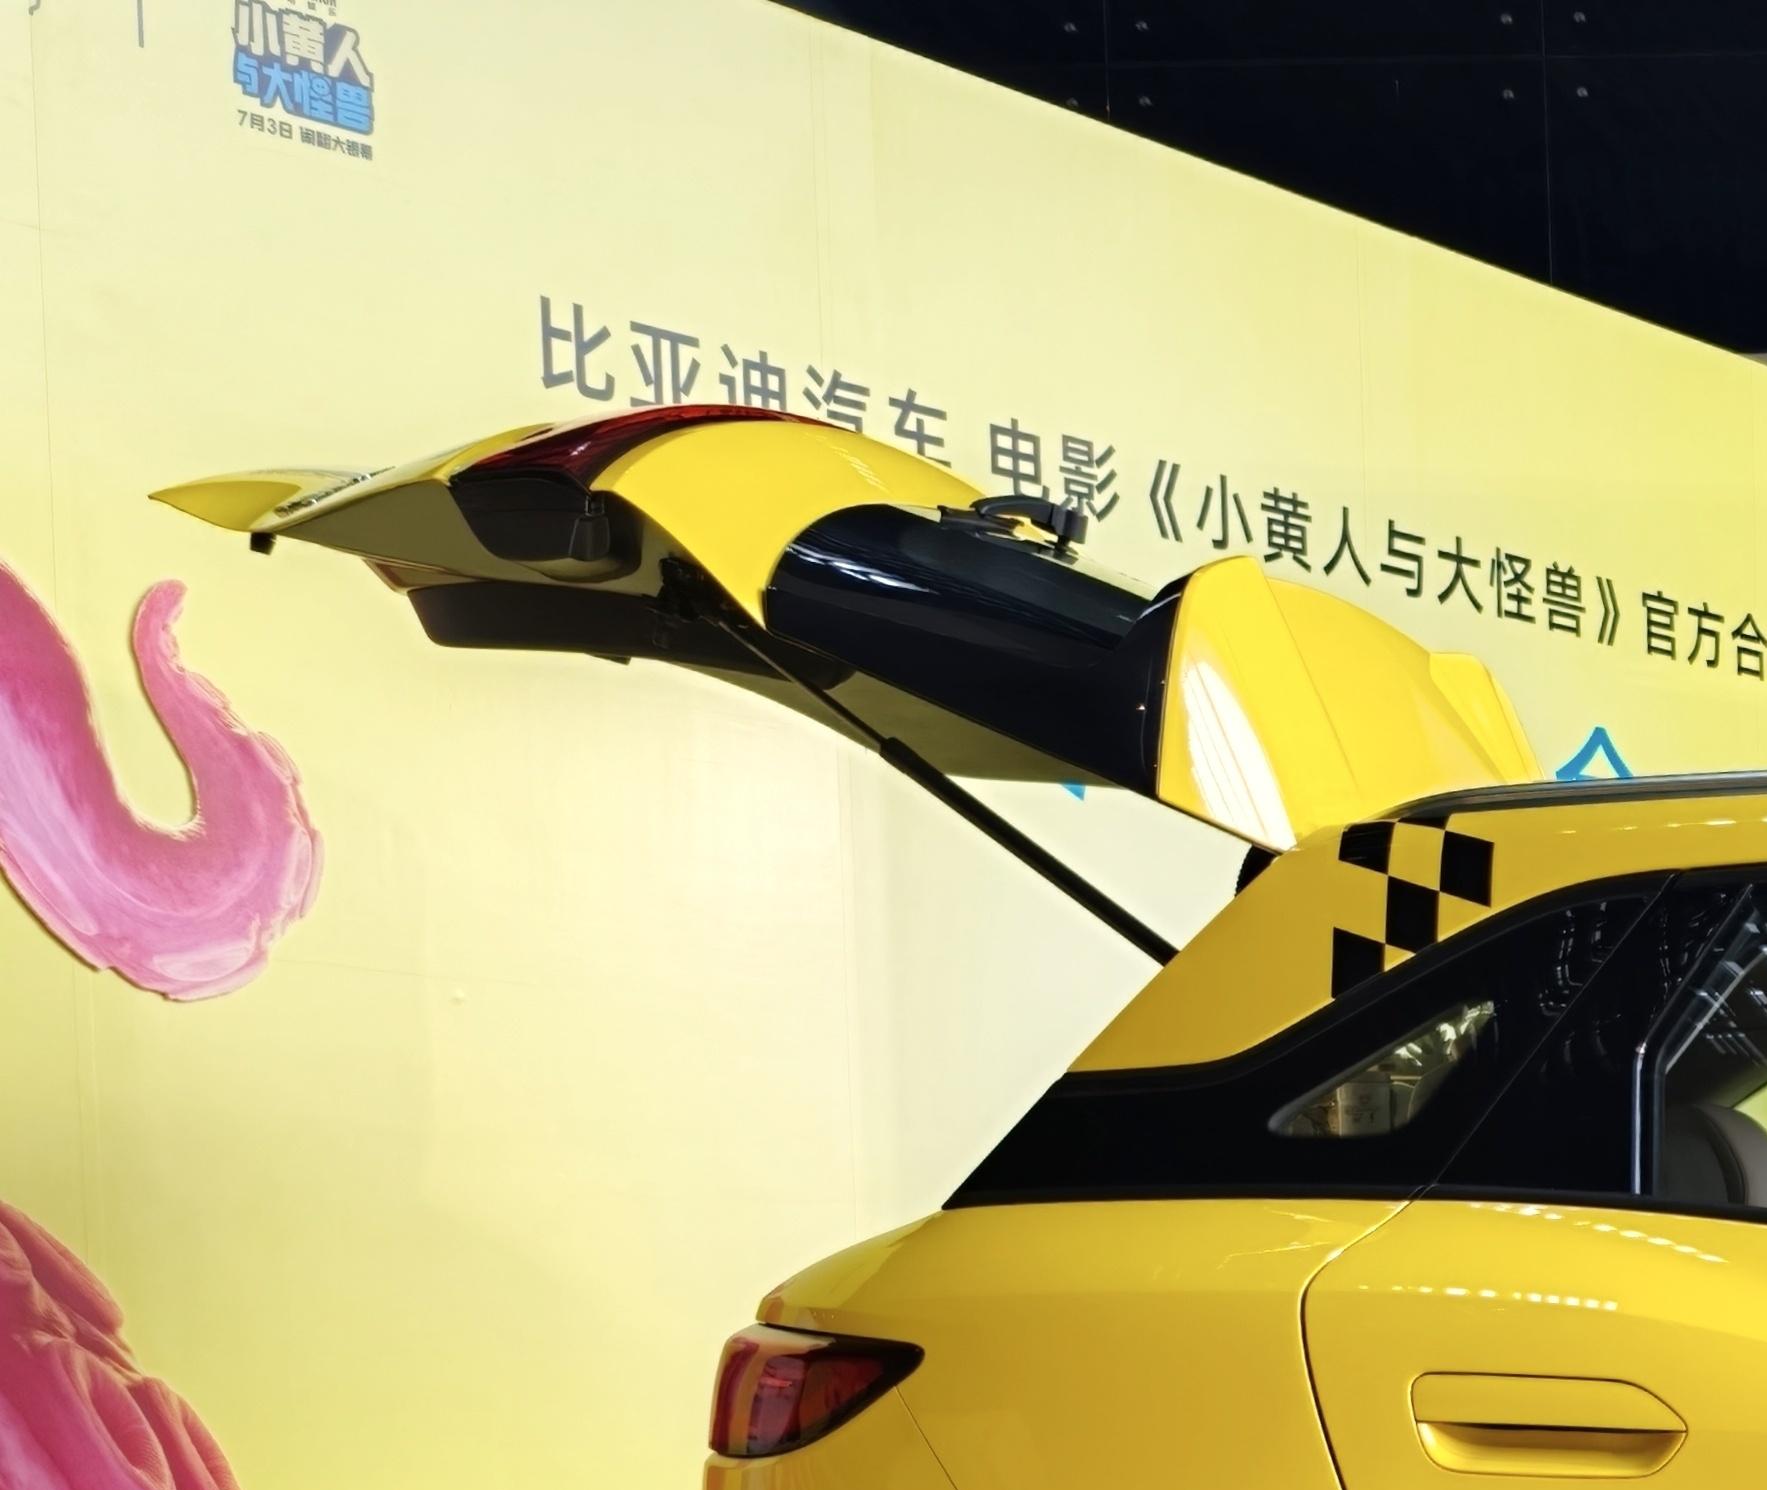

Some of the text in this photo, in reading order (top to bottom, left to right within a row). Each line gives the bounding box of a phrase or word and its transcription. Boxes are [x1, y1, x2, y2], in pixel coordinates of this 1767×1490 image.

[232, 0, 374, 90] 小黄人
[234, 50, 374, 134] 与大怪兽
[237, 109, 293, 140] 7月3日
